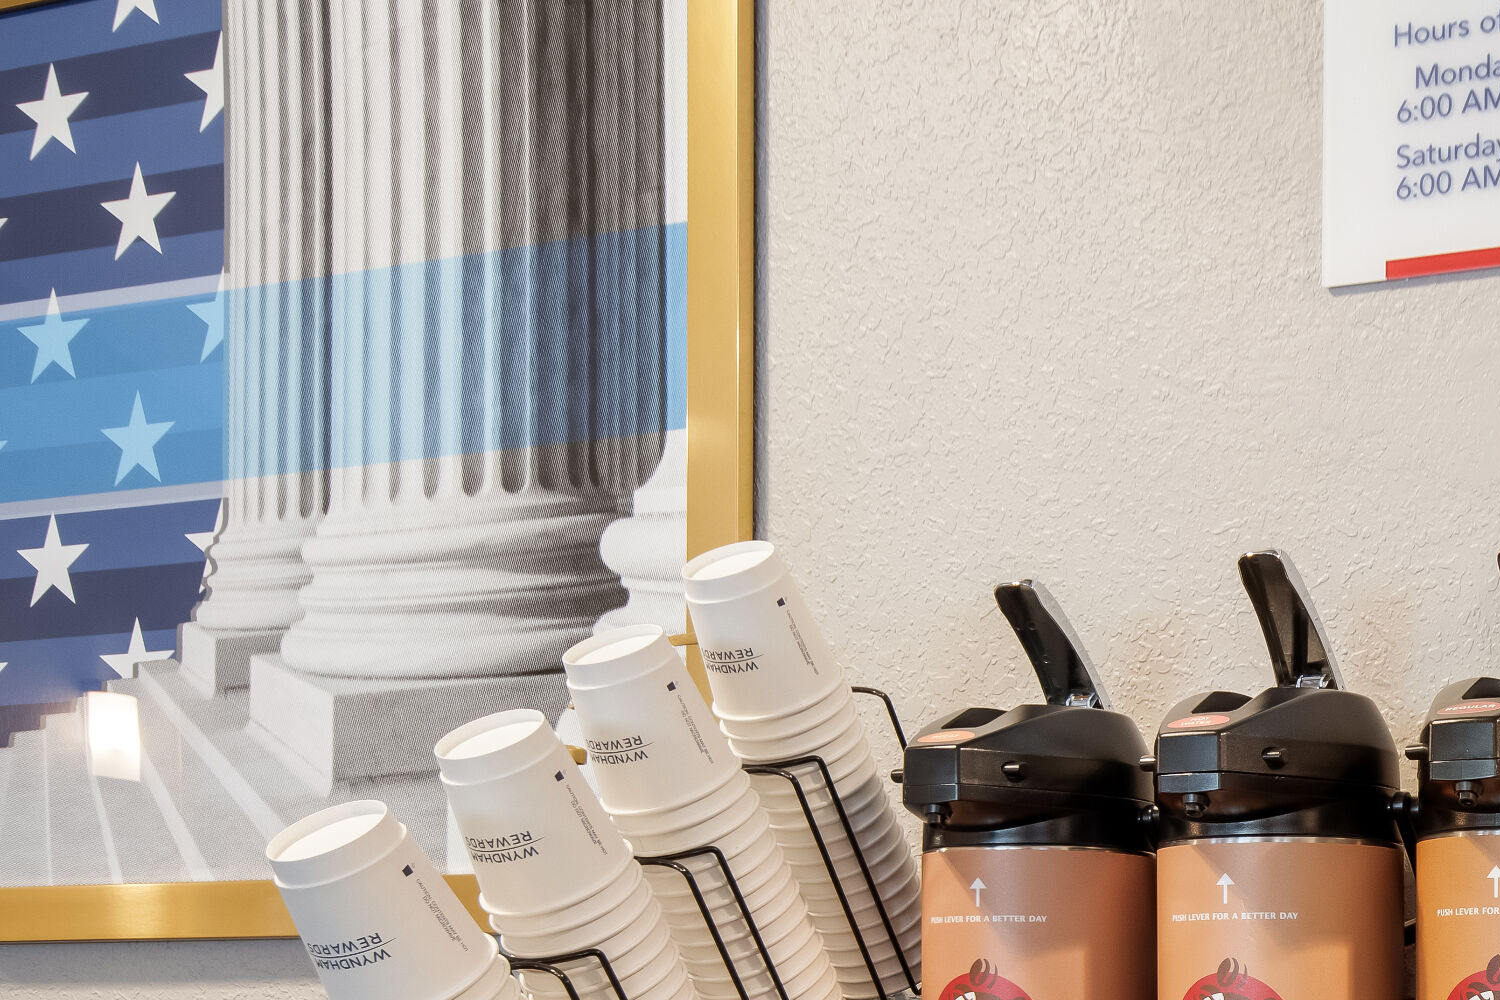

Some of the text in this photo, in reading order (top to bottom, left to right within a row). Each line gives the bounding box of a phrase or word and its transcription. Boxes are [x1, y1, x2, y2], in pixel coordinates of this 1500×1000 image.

[1394, 18, 1469, 47] Hours
[1397, 94, 1453, 123] 6:00
[1396, 171, 1452, 200] 6:00
[472, 846, 540, 864] WYNDHAM
[945, 915, 963, 923] LEVER
[966, 915, 981, 923] FOR
[1189, 913, 1209, 921] LEVER
[1212, 912, 1229, 920] FOR
[1232, 912, 1239, 920] A
[1241, 912, 1277, 920] BETTER
[1280, 912, 1298, 920] DAY
[1437, 908, 1453, 917] PUSH
[1456, 907, 1479, 915] LEVER
[1482, 907, 1500, 915] FOR
[317, 948, 392, 970] WYNDHAM
